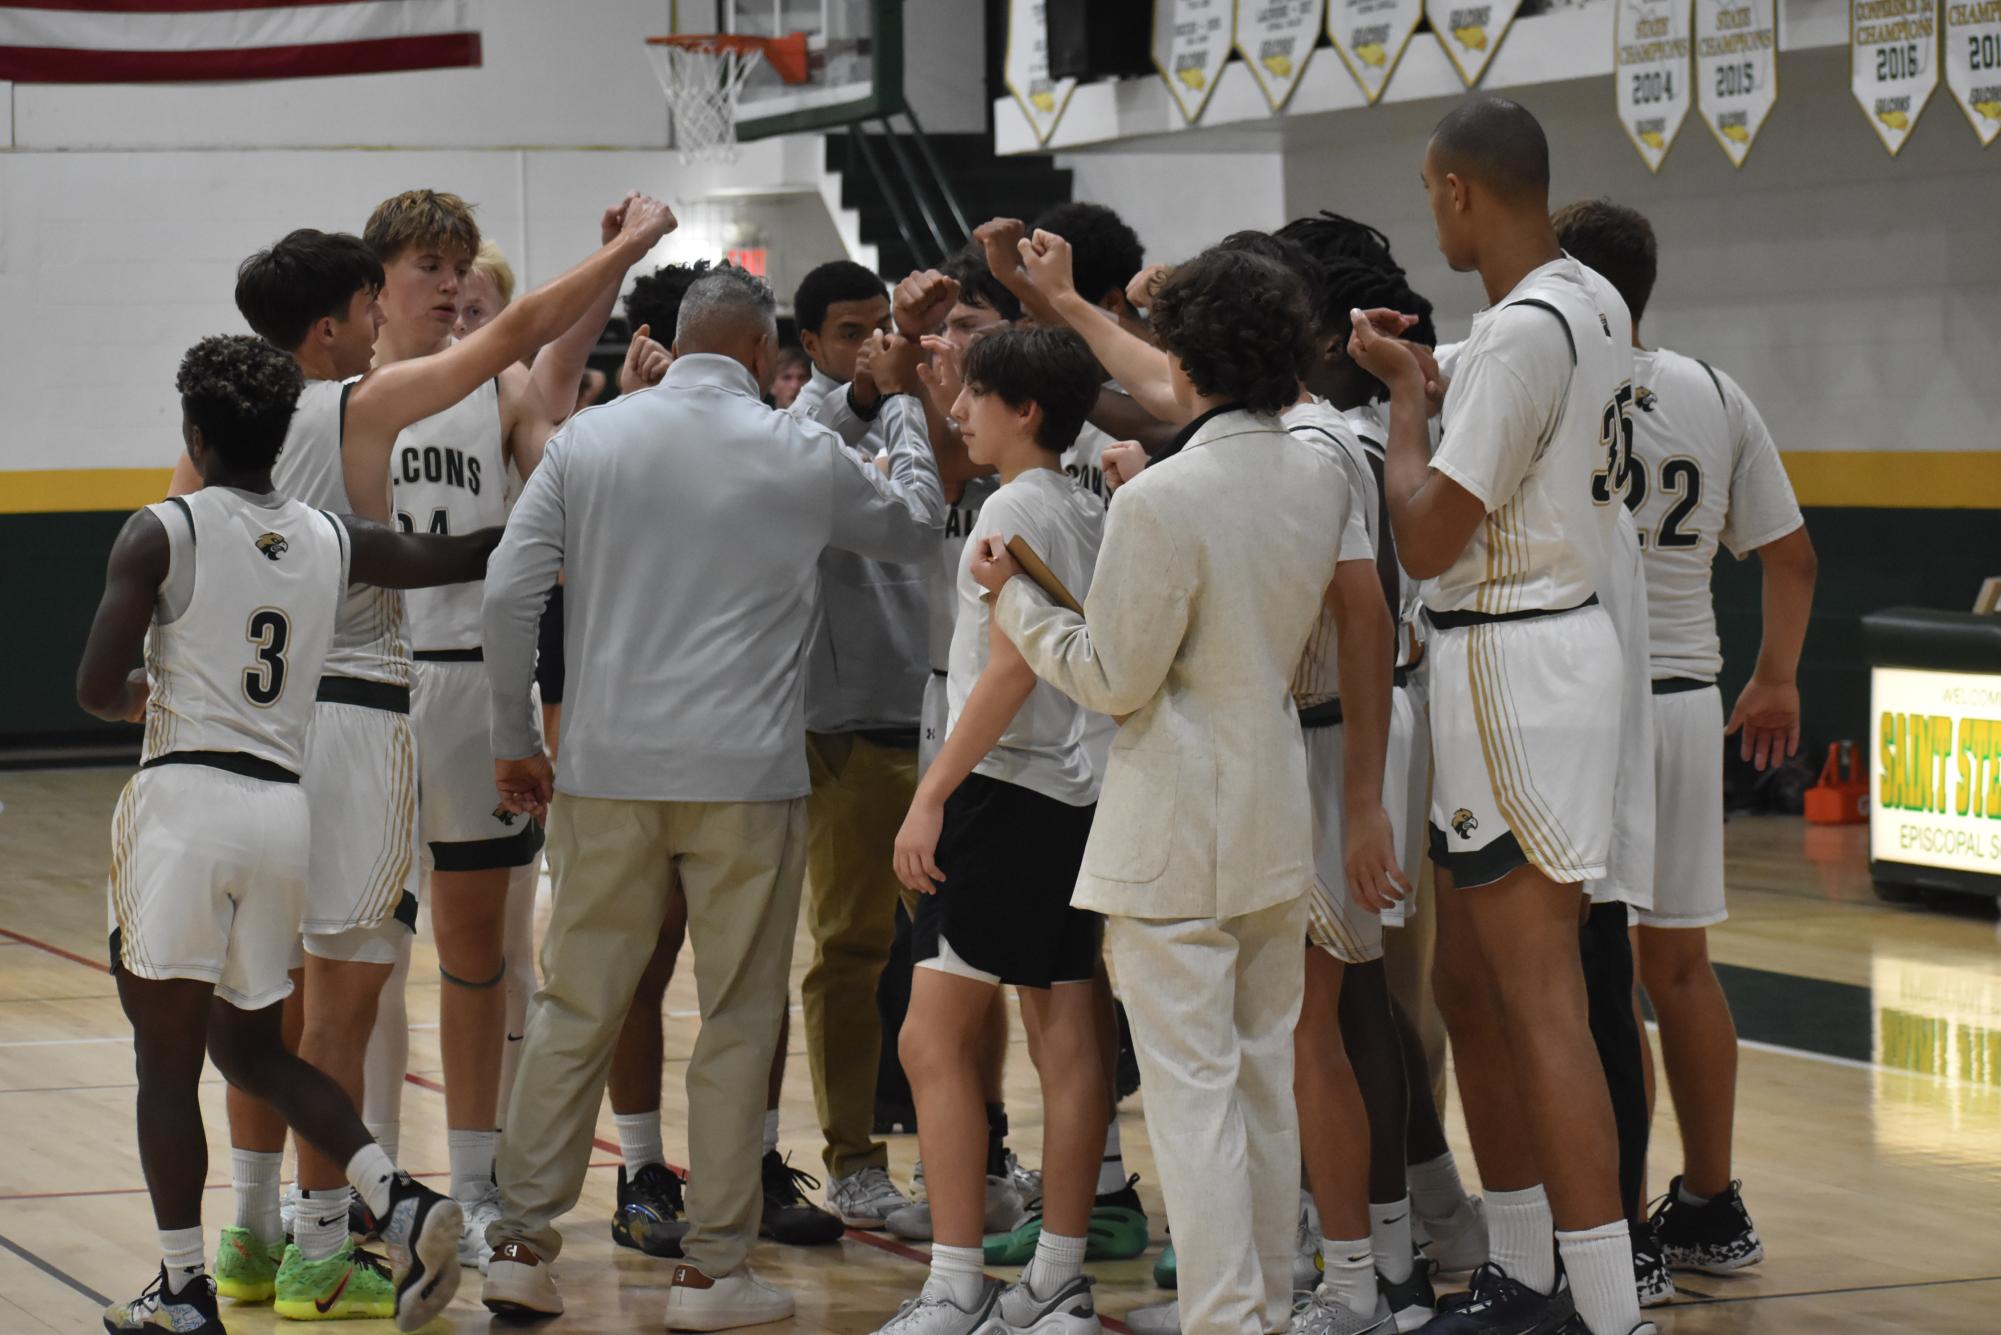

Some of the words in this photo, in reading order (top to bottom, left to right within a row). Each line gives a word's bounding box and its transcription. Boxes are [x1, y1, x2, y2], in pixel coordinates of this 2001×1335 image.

[1856, 18, 1934, 46] CHAMPIONS
[1716, 62, 1754, 98] 2015
[1876, 44, 1918, 82] 2016
[1633, 70, 1673, 105] 2004
[393, 446, 482, 496] CONS
[241, 606, 291, 709] 3
[1880, 711, 1953, 815] SAINT
[1900, 824, 1984, 858] EPISCOPAL
